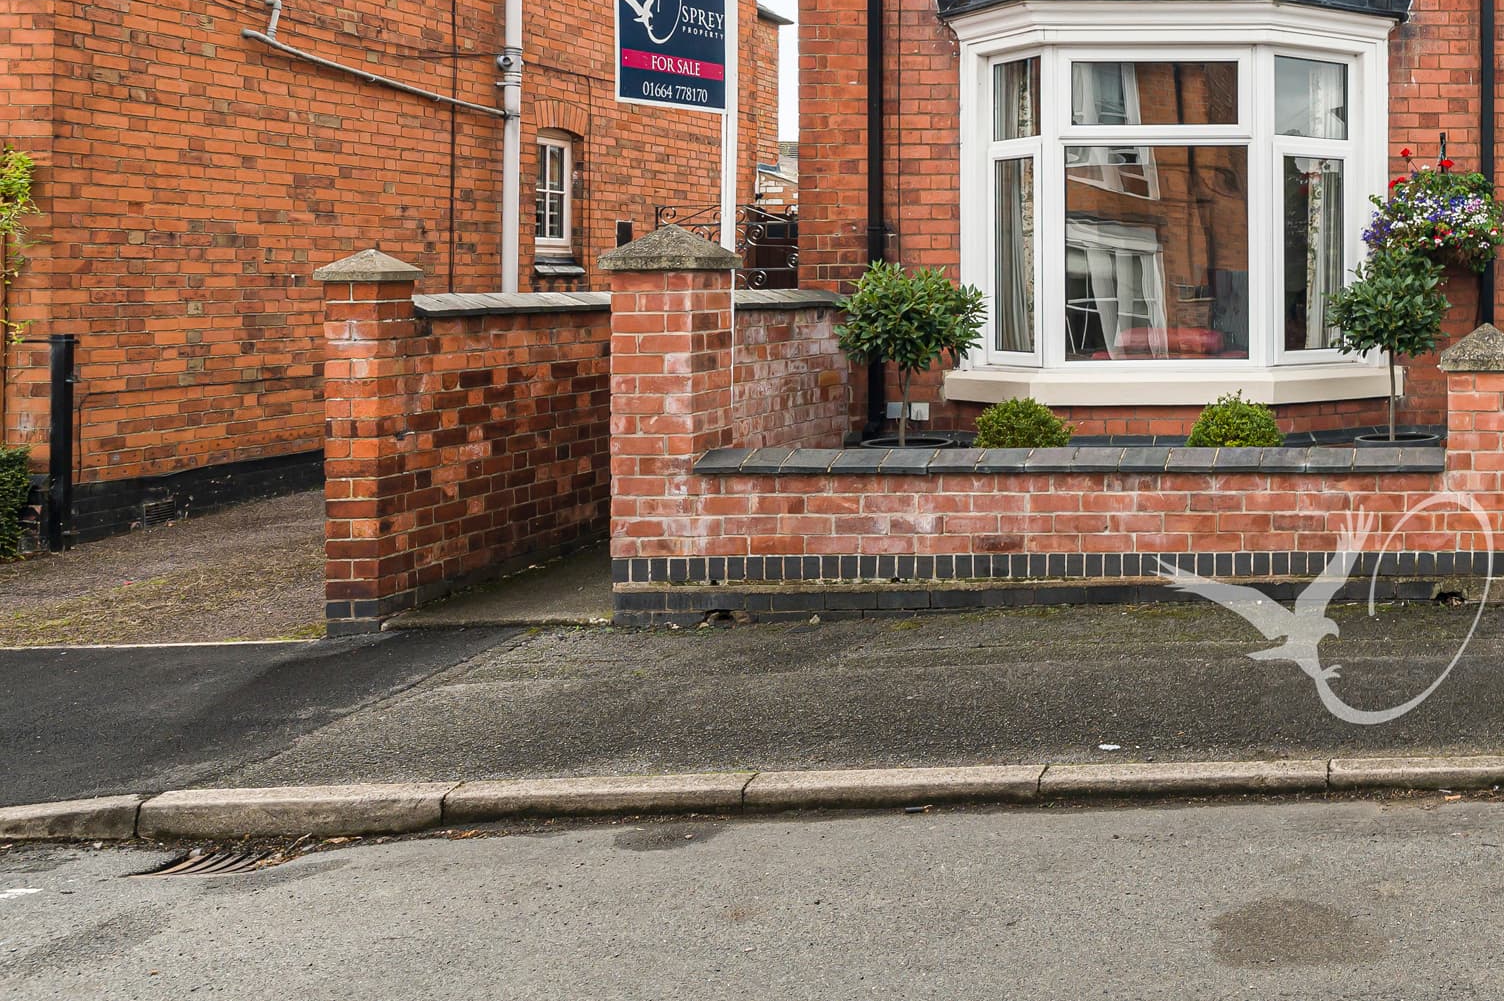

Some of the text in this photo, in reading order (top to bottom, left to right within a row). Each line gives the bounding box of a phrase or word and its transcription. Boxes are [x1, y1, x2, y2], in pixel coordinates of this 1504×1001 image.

[682, 26, 724, 40] PROPERTY
[651, 55, 701, 77] FOR SALE
[642, 81, 708, 103] 01664 778170
